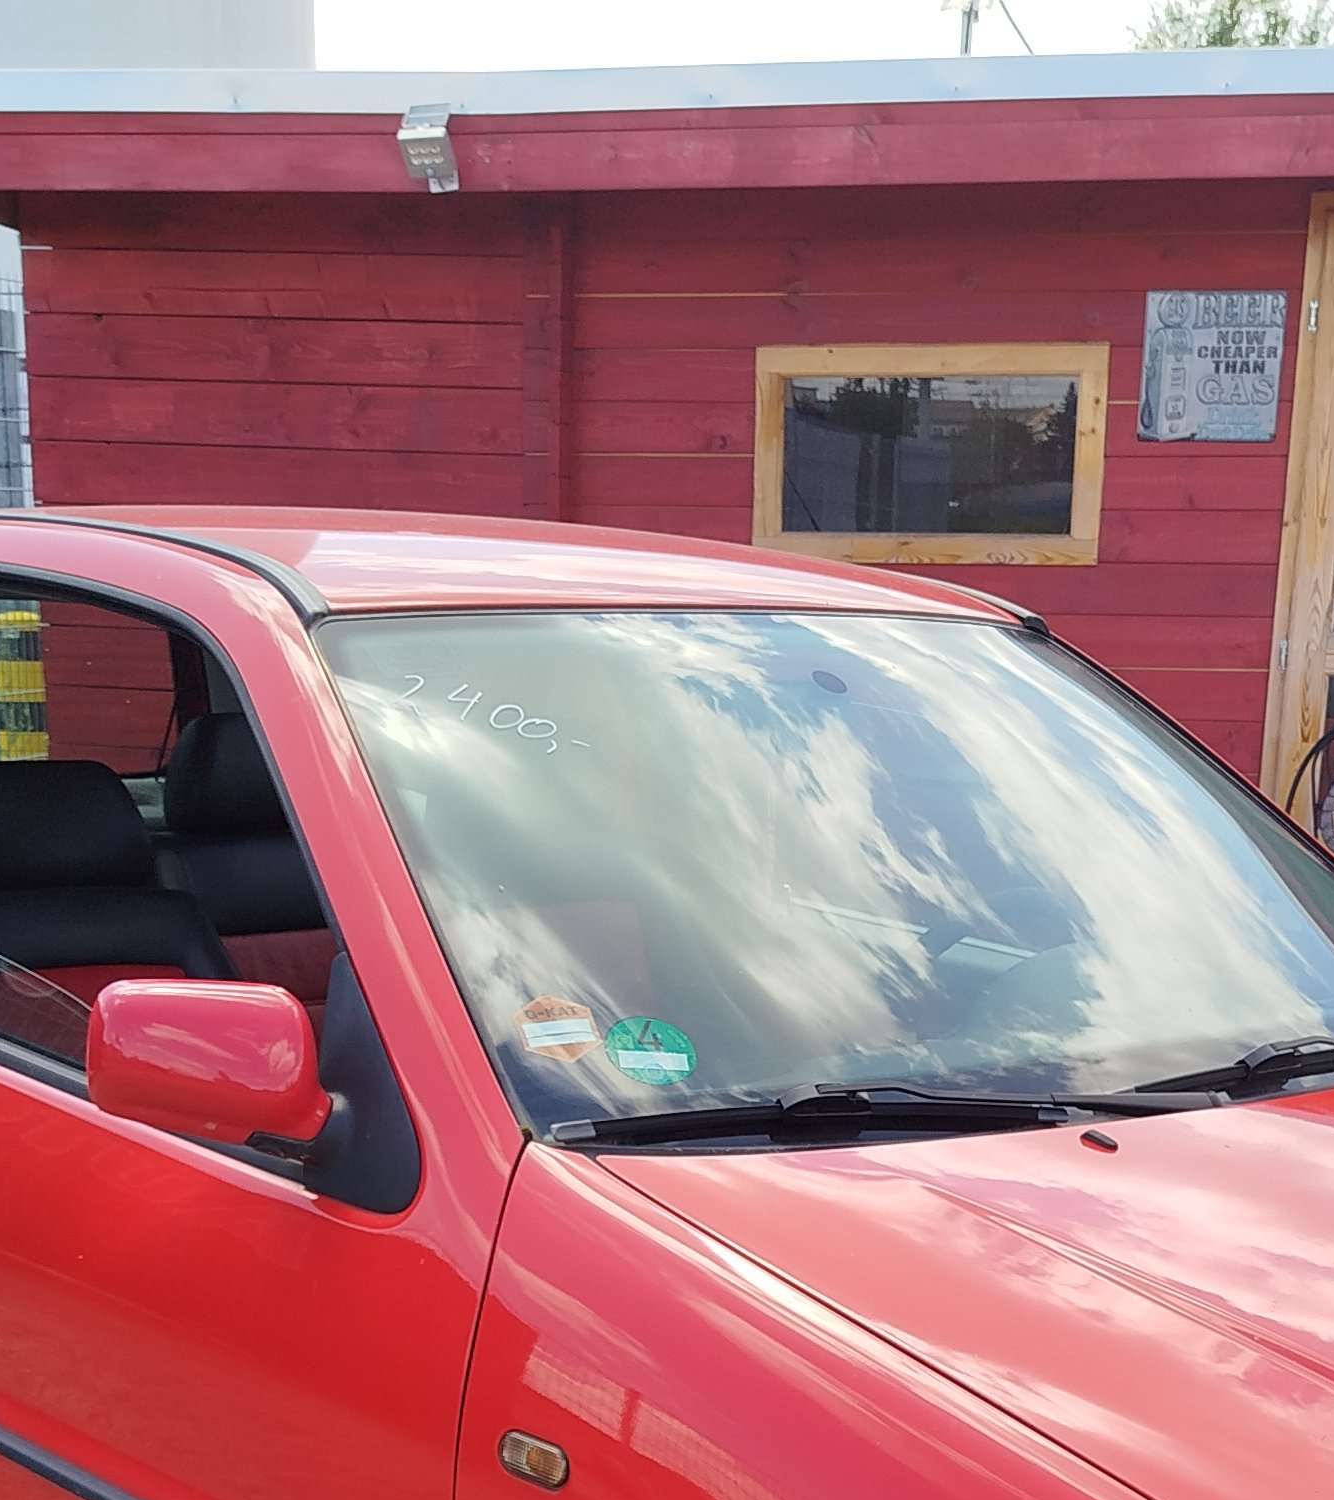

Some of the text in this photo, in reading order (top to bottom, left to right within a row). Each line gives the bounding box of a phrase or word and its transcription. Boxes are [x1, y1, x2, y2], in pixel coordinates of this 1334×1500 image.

[1216, 329, 1267, 346] NOW
[1197, 345, 1279, 360] CHEAPER
[1212, 359, 1267, 375] THAN
[1195, 373, 1276, 406] GAS
[637, 1019, 664, 1051] 4
